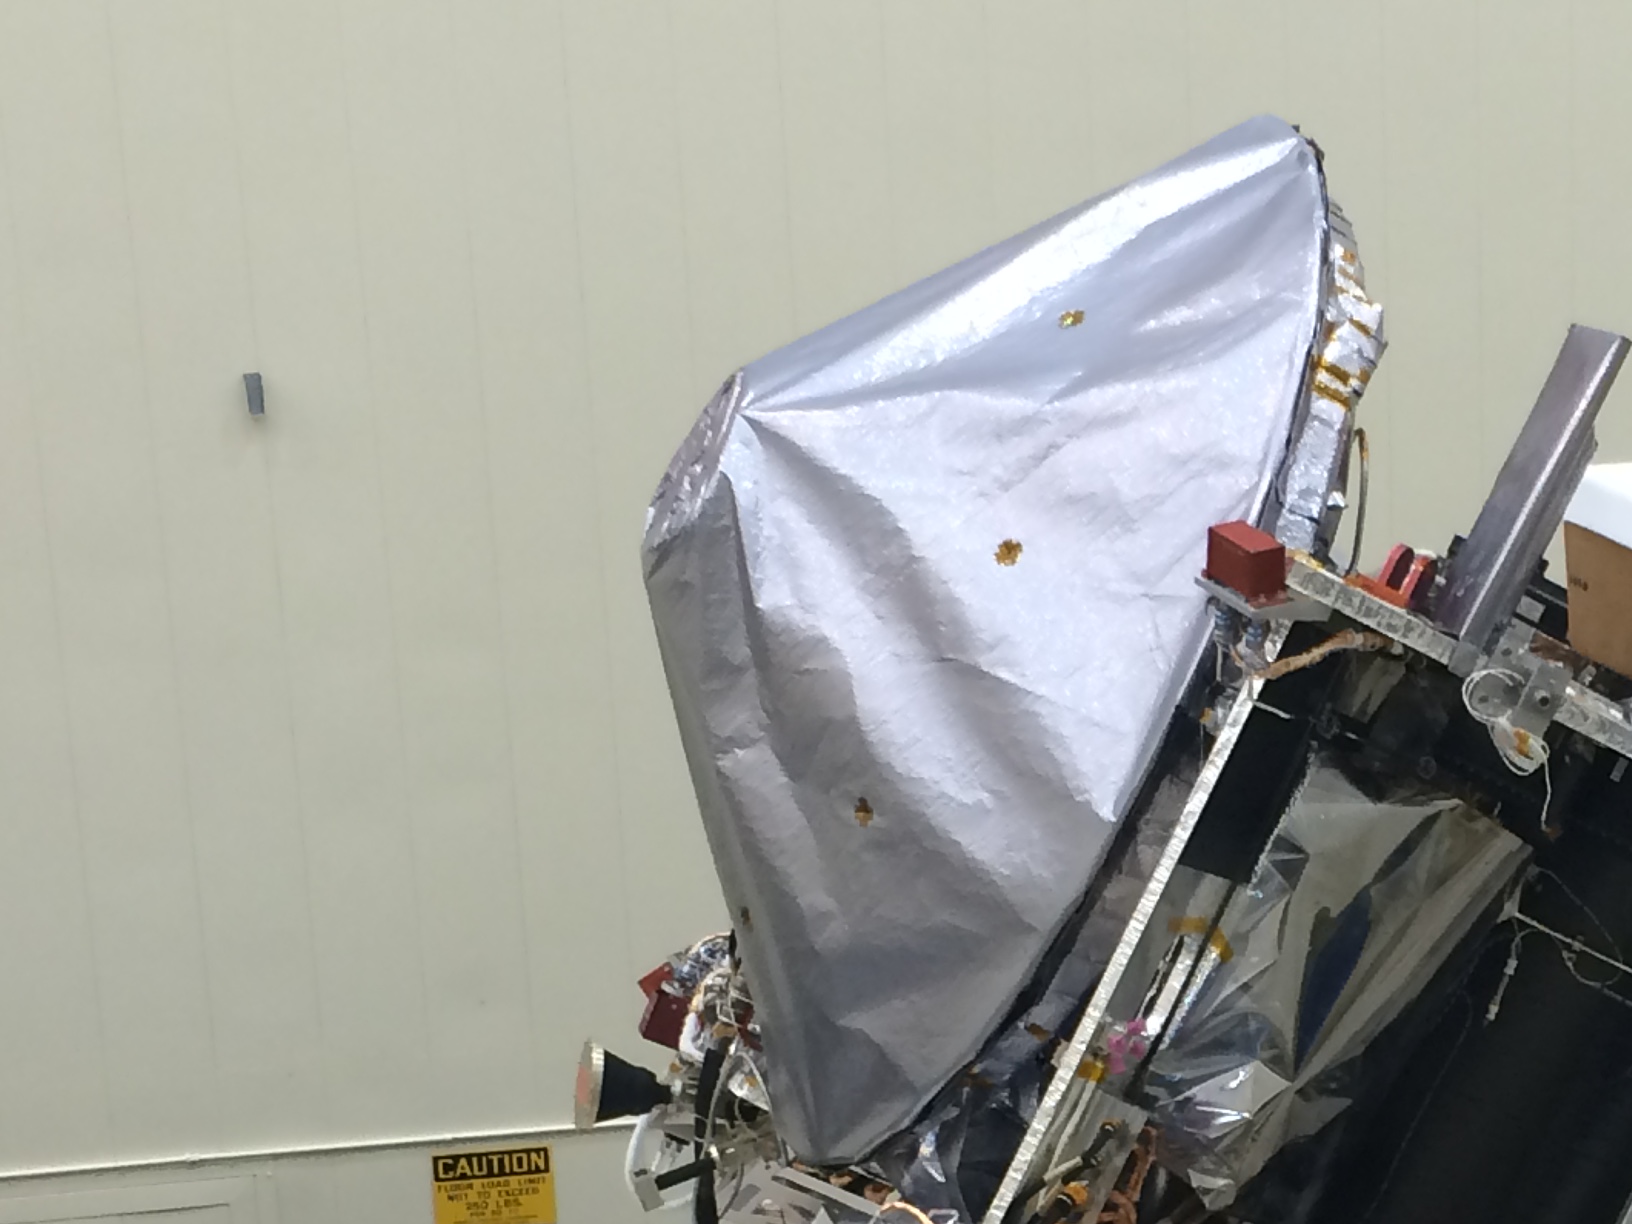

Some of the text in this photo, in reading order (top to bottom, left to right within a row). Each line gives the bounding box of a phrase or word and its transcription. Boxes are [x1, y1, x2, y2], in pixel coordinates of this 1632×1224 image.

[437, 1150, 545, 1179] CAUTION
[481, 1179, 511, 1189] LOAD
[477, 1190, 491, 1200] TO
[498, 1186, 540, 1198] EXCEED
[466, 1200, 489, 1211] 250
